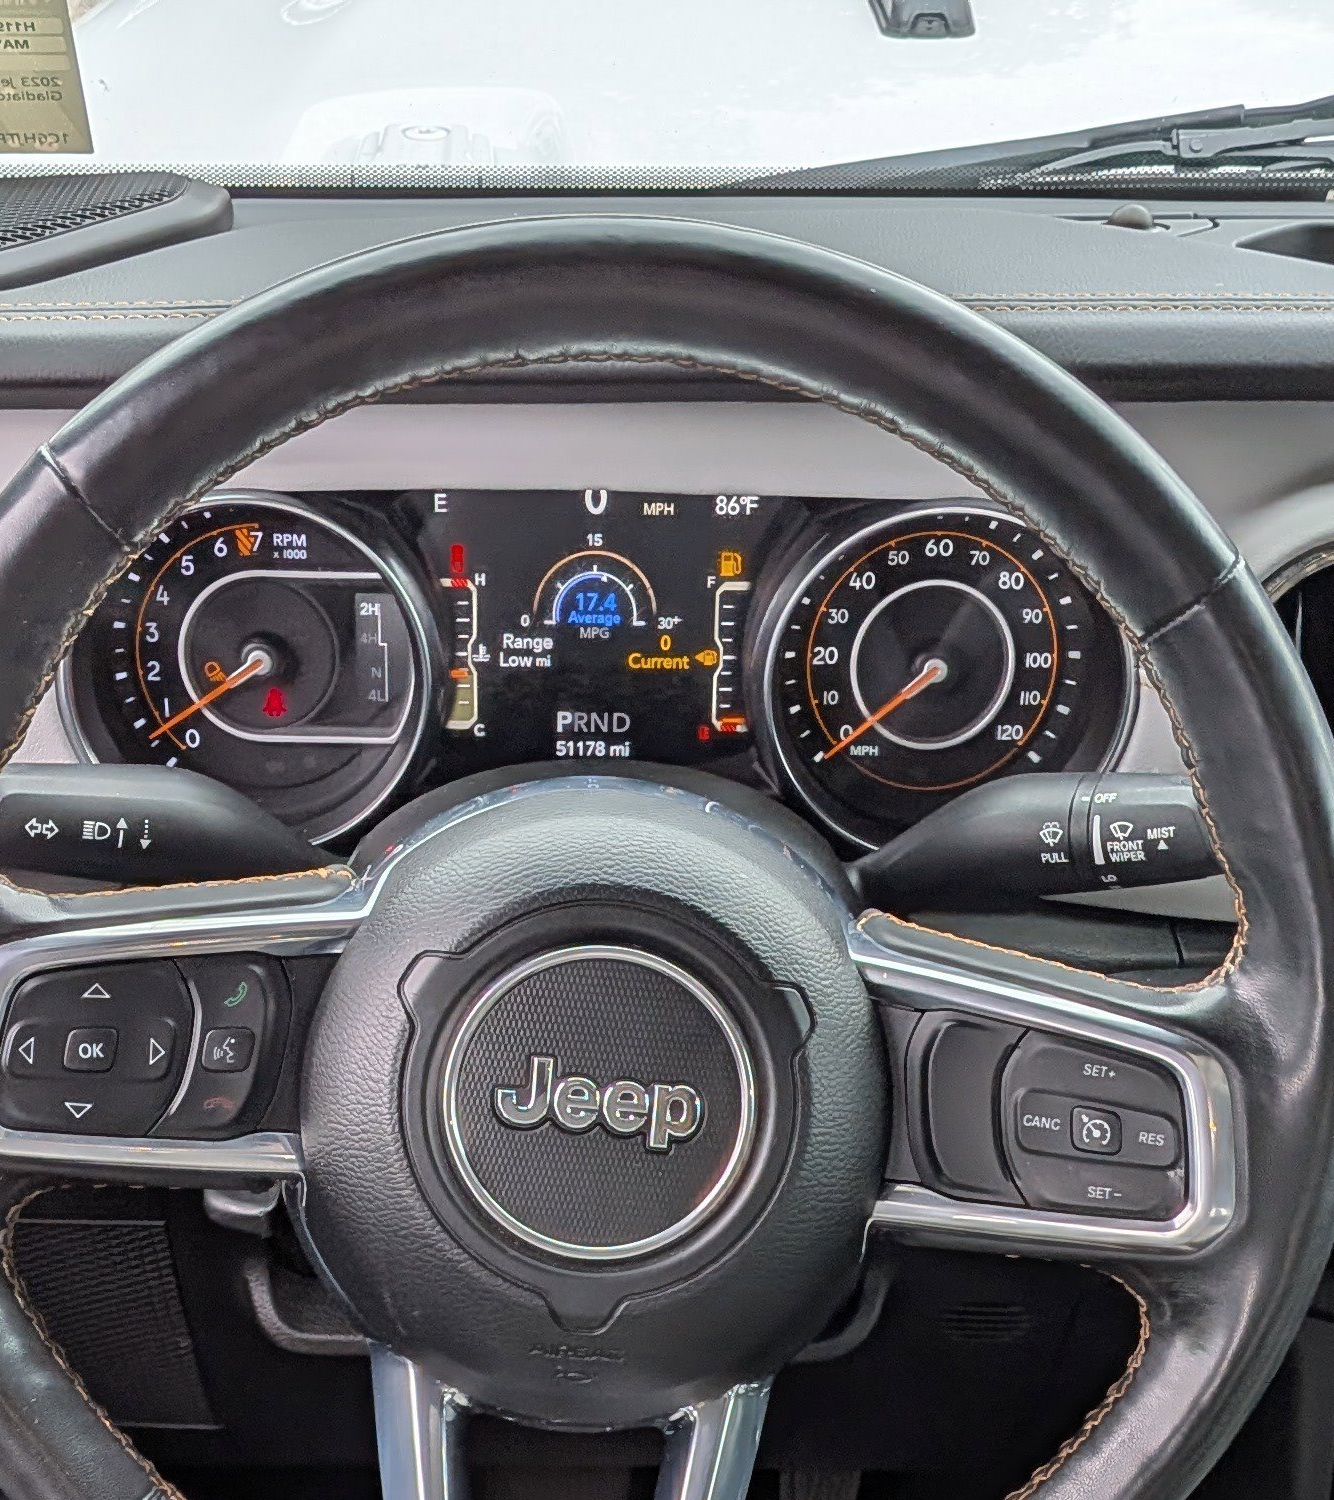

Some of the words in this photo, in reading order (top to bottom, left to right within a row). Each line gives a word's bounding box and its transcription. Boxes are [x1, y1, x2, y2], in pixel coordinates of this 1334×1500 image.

[434, 493, 447, 513] E
[643, 503, 675, 516] MPH
[715, 495, 759, 515] 86°F
[214, 536, 227, 557] 6
[250, 531, 263, 552] 7
[272, 533, 307, 547] RPM
[587, 534, 603, 547] 15
[924, 538, 954, 557] 60
[283, 549, 307, 560] 1000
[887, 550, 910, 566] 50
[969, 550, 990, 566] 70
[180, 555, 195, 576] 5
[474, 573, 486, 586] H
[707, 576, 716, 588] F
[849, 571, 876, 590] 40
[998, 571, 1024, 590] 80
[156, 585, 170, 606] 4
[575, 592, 618, 611] 17.4
[359, 603, 378, 616] 2H
[827, 608, 849, 624] 30
[1022, 608, 1043, 624] 90
[521, 614, 530, 627] 0
[568, 612, 621, 627] Average
[657, 615, 682, 630] 30+
[145, 622, 159, 642] 3
[579, 627, 610, 639] MPG
[503, 633, 554, 651] Range
[660, 636, 671, 651] 0
[499, 652, 533, 667] Low
[535, 655, 551, 667] mi
[628, 653, 690, 670] Current
[812, 646, 838, 665] 20
[1025, 652, 1052, 669] 100
[147, 661, 161, 681] 2
[371, 667, 382, 678] N
[368, 690, 383, 702] 4L
[822, 690, 839, 706] 10
[1019, 690, 1041, 706] 110
[164, 698, 170, 718] 1
[185, 728, 200, 749] 0
[473, 724, 486, 737] C
[839, 724, 854, 741] 0
[997, 724, 1024, 741] 120
[555, 741, 606, 757] 51178
[609, 742, 630, 758] mi
[850, 745, 879, 757] MPH
[1094, 793, 1117, 804] OFF
[1146, 826, 1175, 839] MIST
[1106, 840, 1144, 851] FRONT
[1040, 852, 1069, 864] PULL
[1108, 851, 1147, 863] WIPER
[78, 1043, 105, 1060] OK
[495, 1055, 703, 1150] Jeep
[1022, 1114, 1061, 1131] CANC
[1138, 1131, 1165, 1146] RES
